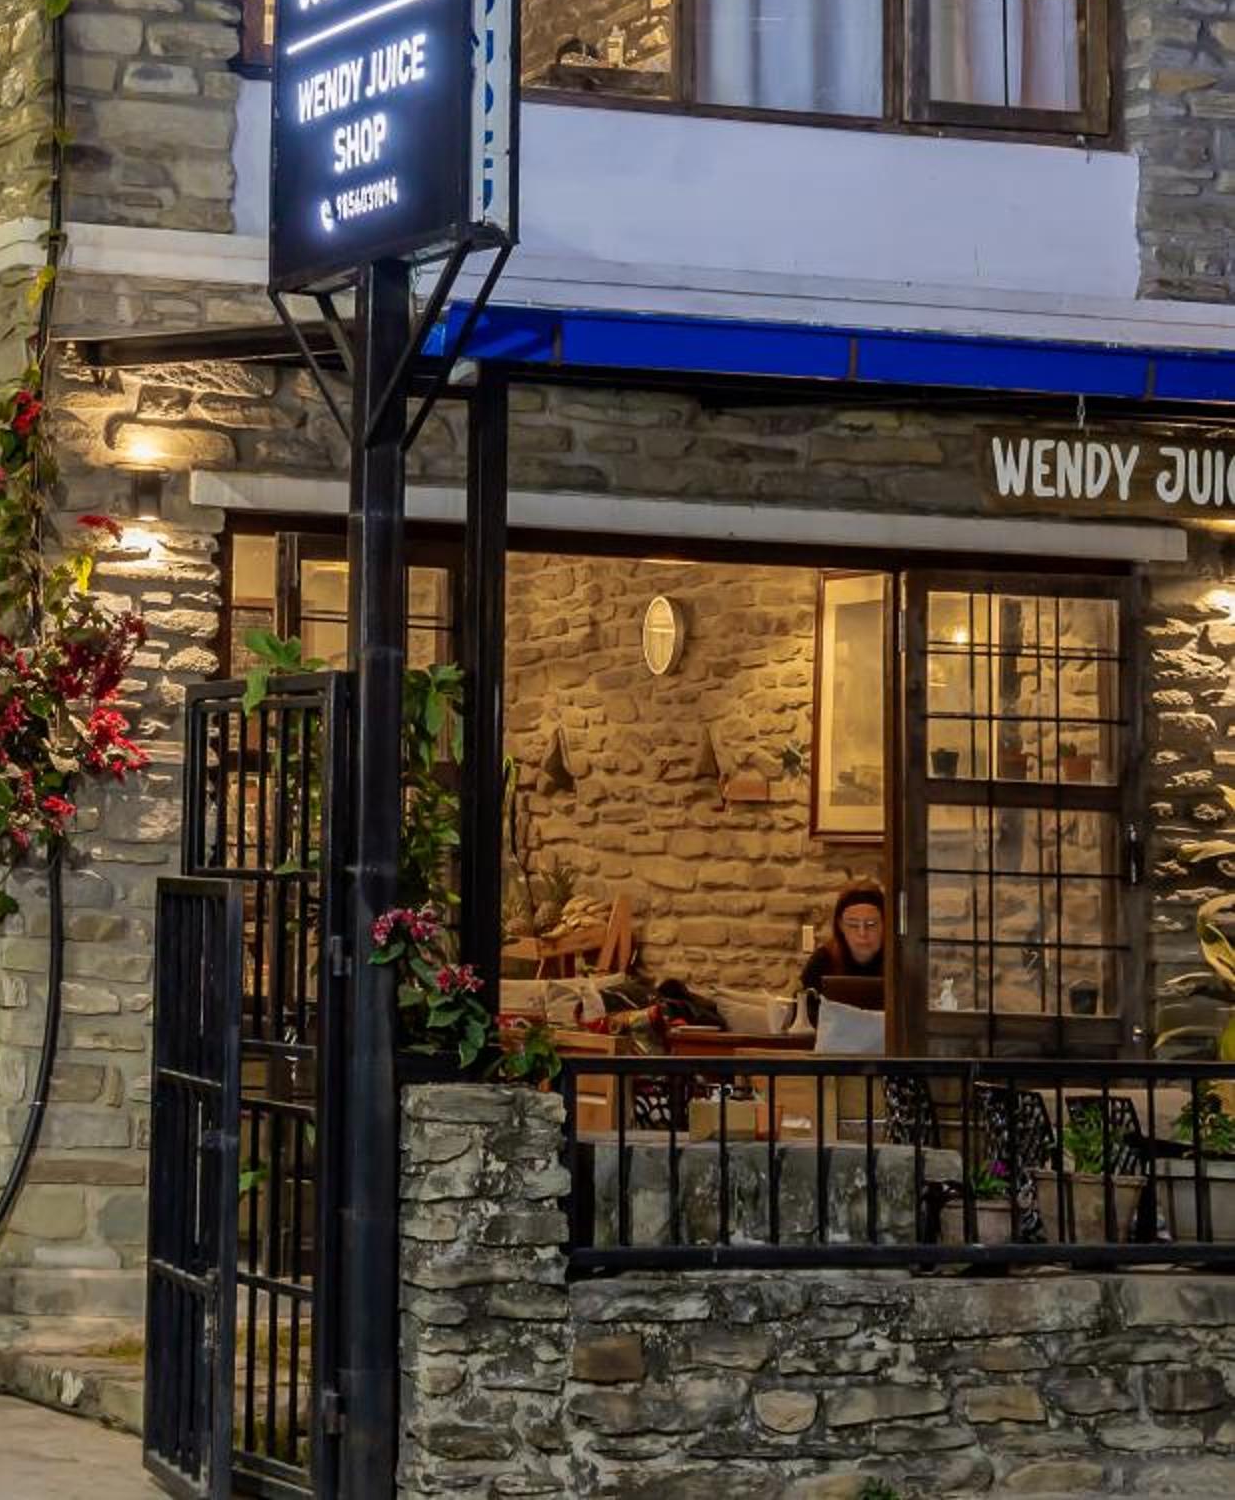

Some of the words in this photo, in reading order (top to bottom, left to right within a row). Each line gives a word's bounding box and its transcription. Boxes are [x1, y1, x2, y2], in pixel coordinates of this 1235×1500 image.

[299, 57, 363, 123] WENDY
[365, 34, 426, 97] JUICE
[334, 112, 387, 173] SHOP
[992, 437, 1140, 500] WENDY
